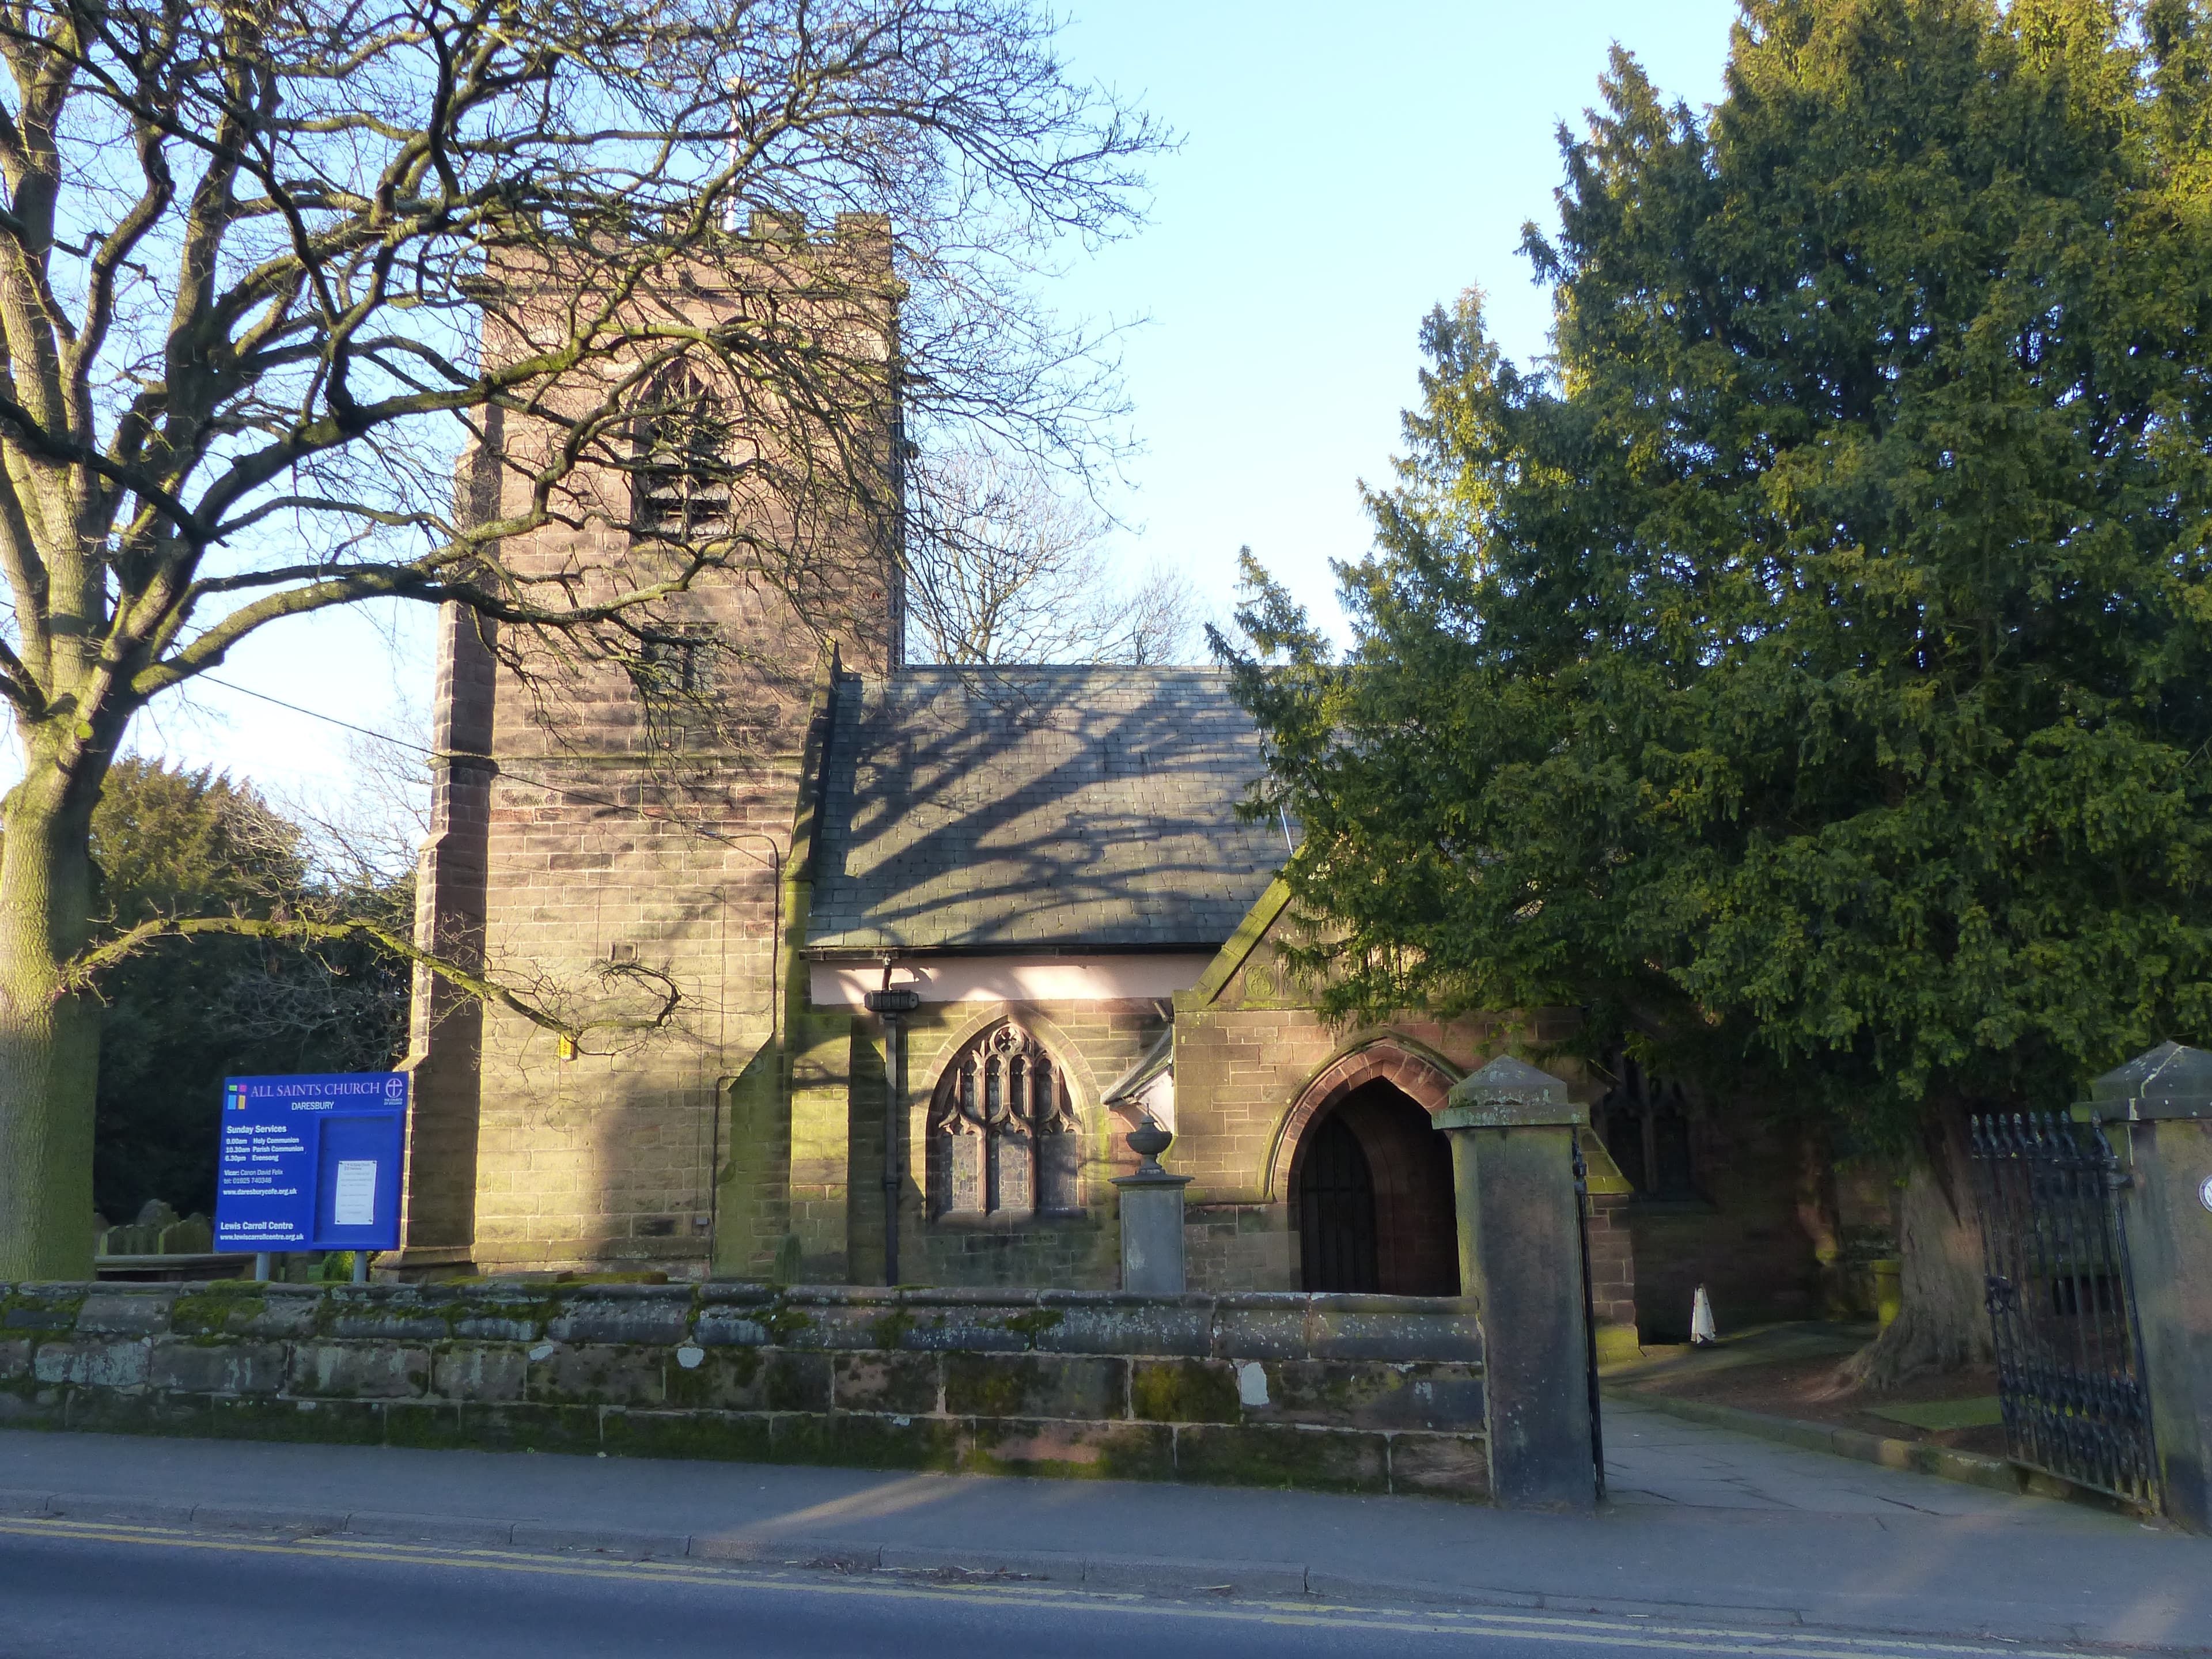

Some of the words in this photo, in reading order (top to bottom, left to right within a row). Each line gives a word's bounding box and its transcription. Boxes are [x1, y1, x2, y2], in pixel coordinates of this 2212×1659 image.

[251, 1085, 274, 1097] ALL
[276, 1084, 321, 1097] SAINTS
[324, 1082, 380, 1096] CHURCH
[291, 1101, 334, 1111] DARESBURY
[227, 1126, 253, 1135] Sunday
[255, 1125, 287, 1133] Services
[223, 1188, 297, 1196] www.daresburycofe.org.uk
[220, 1221, 241, 1230] Lewis
[243, 1221, 267, 1229] Carroll
[268, 1221, 294, 1229] Centre
[219, 1233, 305, 1241] www.lewiscarrollcentre.org.uk
